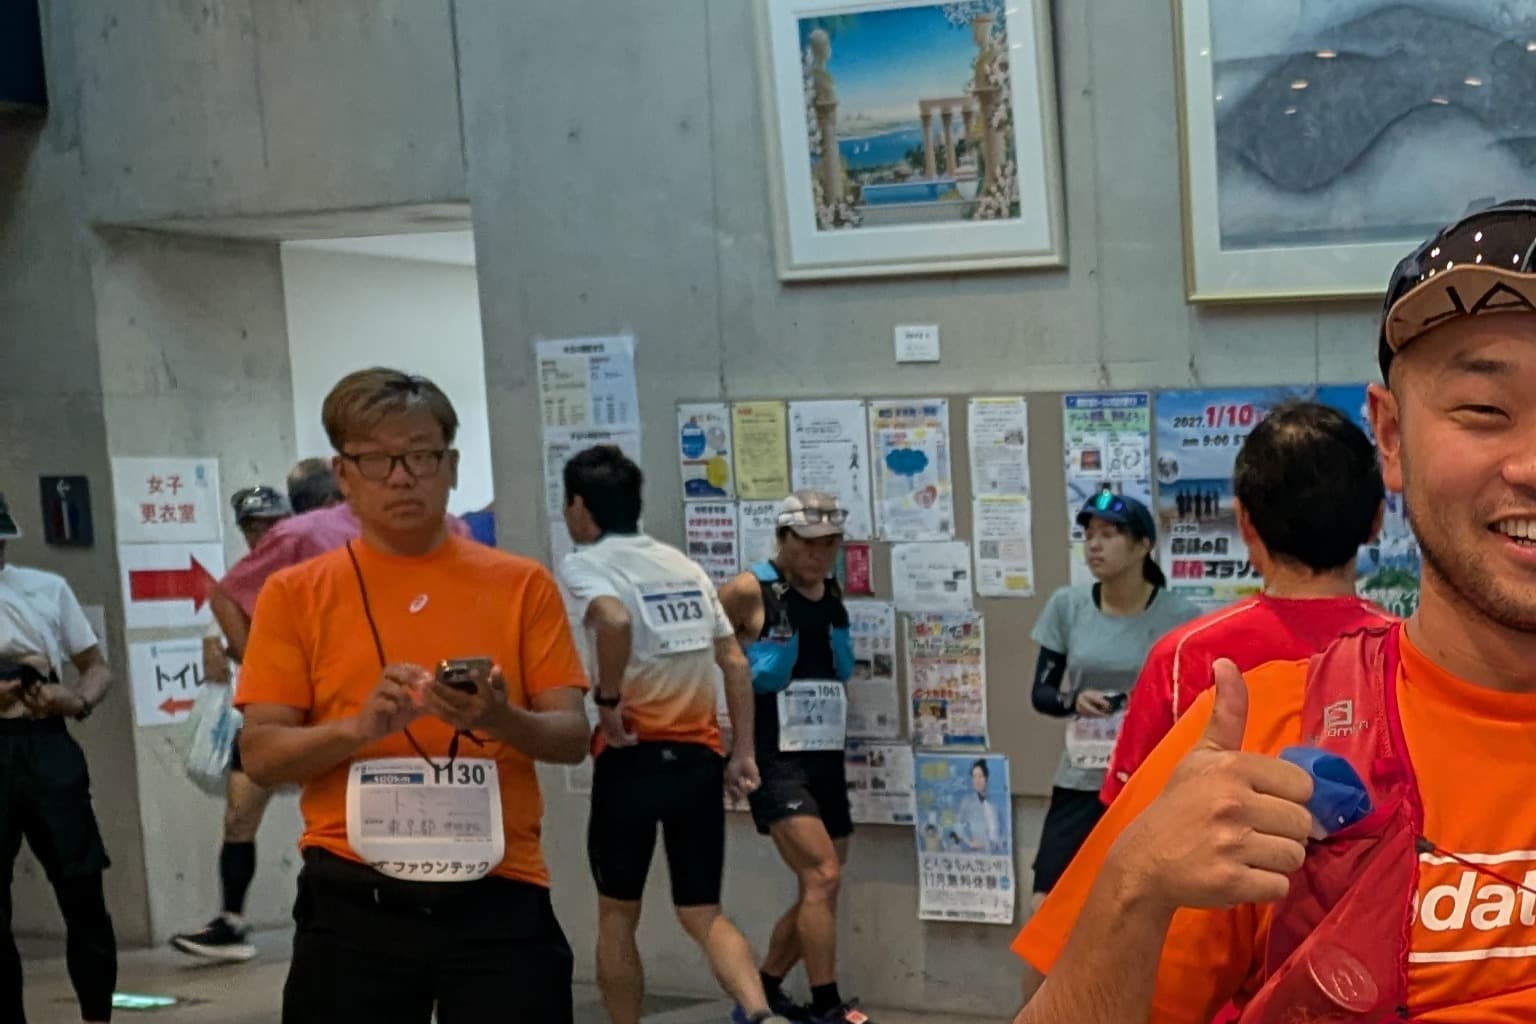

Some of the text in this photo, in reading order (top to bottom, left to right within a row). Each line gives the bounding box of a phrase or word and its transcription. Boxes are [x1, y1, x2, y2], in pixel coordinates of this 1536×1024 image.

[1206, 405, 1253, 427] 1/10
[147, 474, 184, 495] 女子
[140, 503, 196, 524] 更衣室
[657, 601, 703, 623] 1123
[434, 764, 485, 785] 1130
[393, 861, 489, 874] ファウンテック
